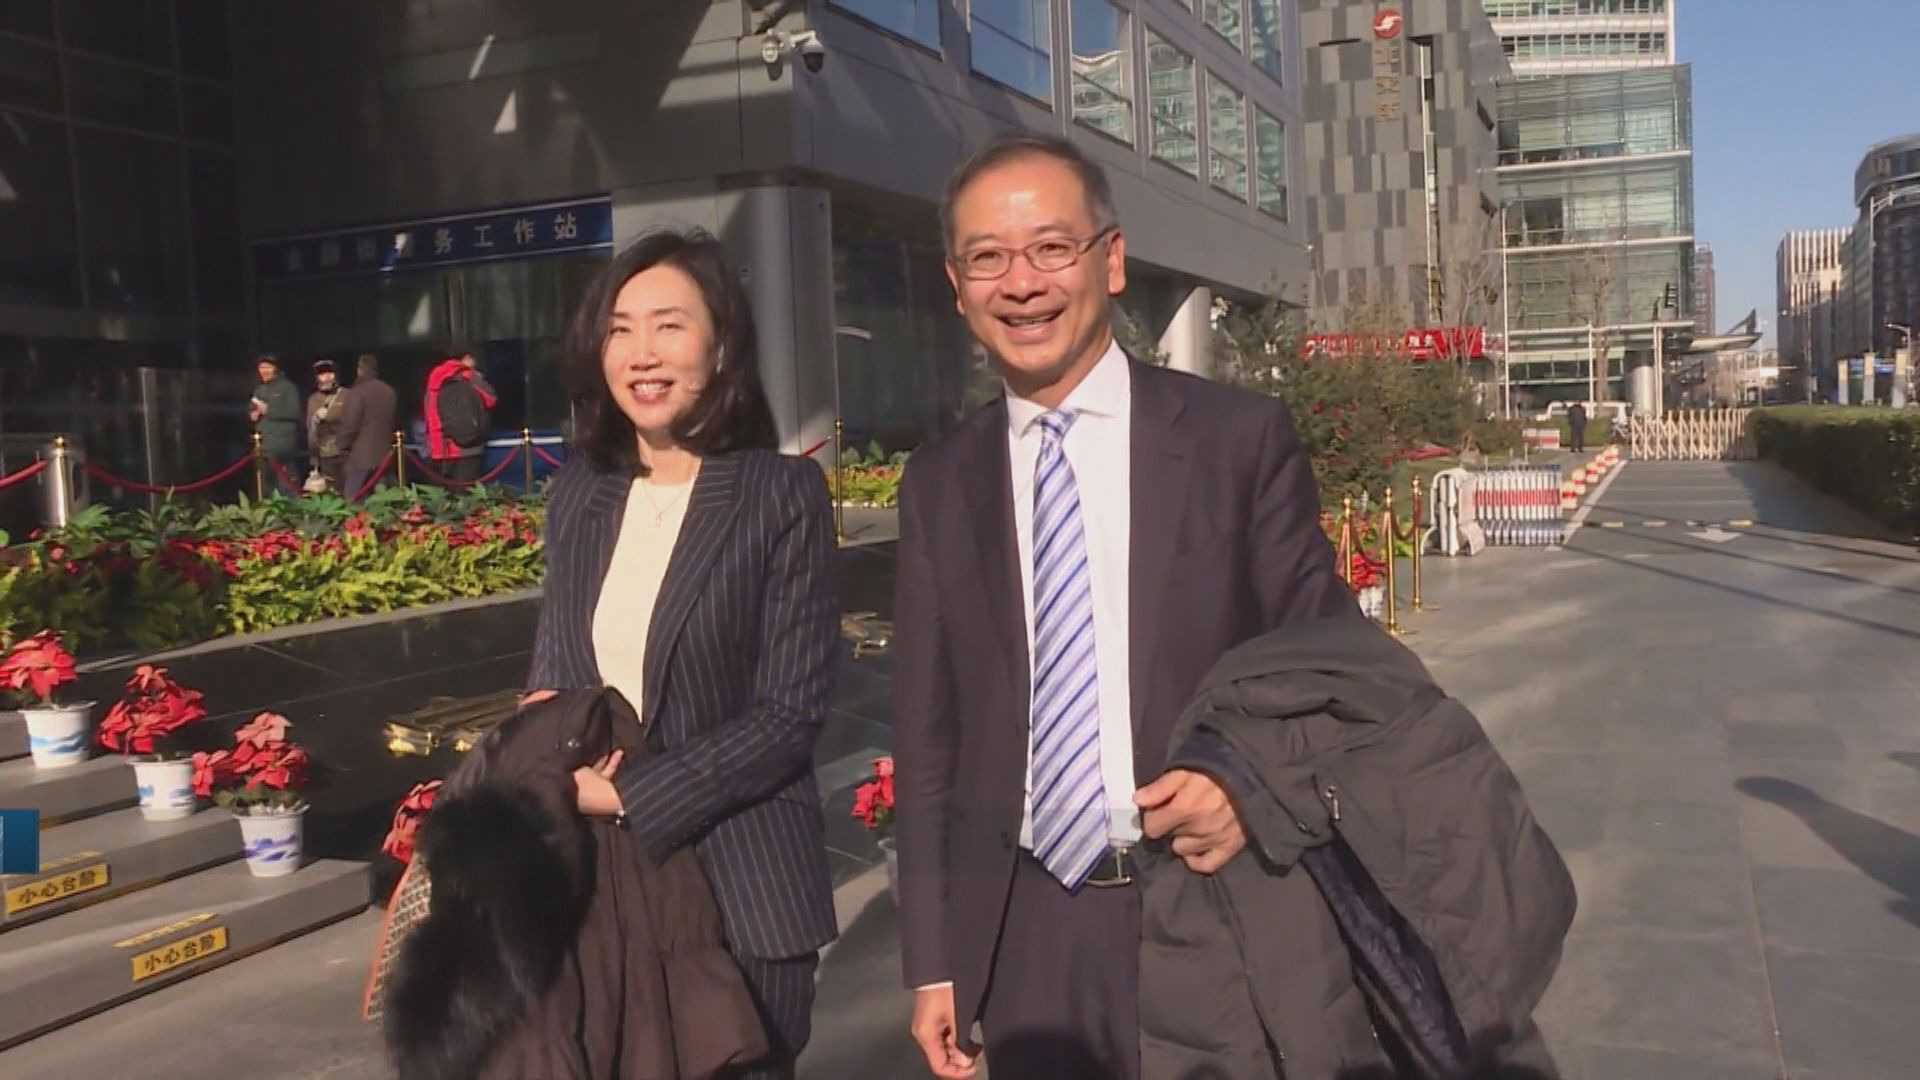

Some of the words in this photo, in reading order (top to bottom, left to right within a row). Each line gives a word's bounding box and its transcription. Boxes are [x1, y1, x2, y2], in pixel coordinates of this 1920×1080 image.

[285, 212, 578, 271] 务工作站
[18, 869, 97, 905] 小心台阶
[143, 933, 216, 971] 小心台阶
